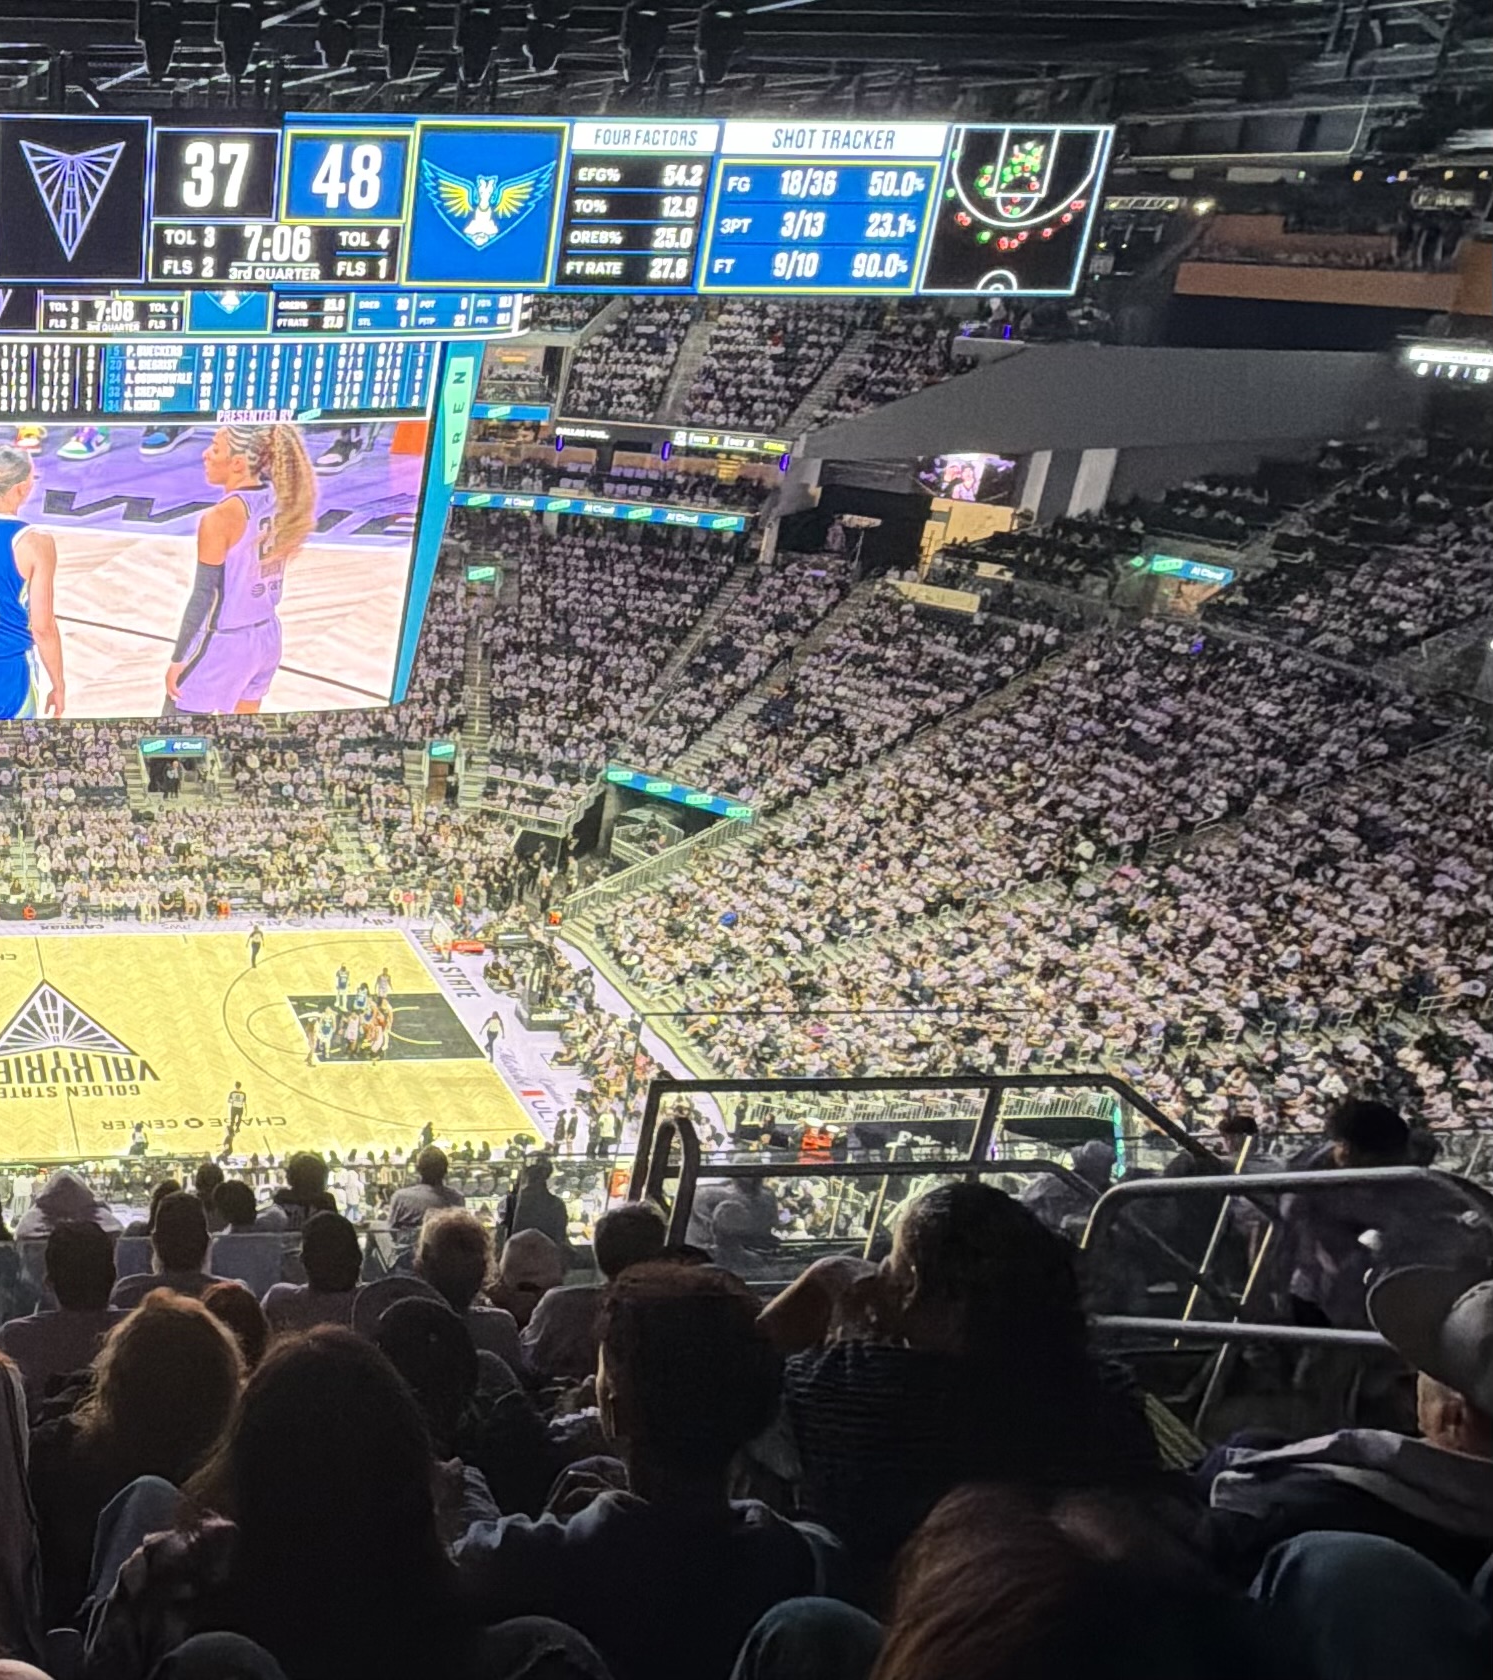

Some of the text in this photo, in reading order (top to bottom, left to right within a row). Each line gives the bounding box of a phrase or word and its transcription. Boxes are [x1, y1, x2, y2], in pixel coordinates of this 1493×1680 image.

[594, 130, 698, 147] FOUR FACTORS
[772, 129, 896, 151] SHOT TRACKER
[182, 142, 250, 208] 37
[311, 144, 382, 210] 48
[578, 167, 621, 183] EFG%
[663, 164, 703, 188] 54.2
[727, 176, 751, 192] FG
[779, 170, 837, 196] 18/36
[868, 171, 925, 196] 50.0%
[574, 199, 608, 215] TO%
[720, 218, 751, 235] 3PT
[779, 212, 826, 238] 3/13
[865, 213, 916, 238] 23.1%
[164, 229, 215, 248] TOL 3
[243, 225, 311, 261] 7:06
[338, 230, 390, 249] TOL 4
[570, 230, 623, 247] OREB%
[163, 258, 214, 278] FLS 2
[228, 266, 321, 281] 3rd QUARTER
[336, 259, 388, 280] FLS 1
[566, 260, 622, 277] FT RATE
[713, 260, 733, 274] FT
[773, 253, 820, 280] 9/10
[852, 253, 908, 280] 90.0%
[48, 302, 69, 313] TOL
[149, 301, 179, 314] TOL 4
[102, 322, 141, 332] QUARTER
[217, 409, 294, 422] PRESENTED BY
[439, 966, 482, 999] STATE
[0, 1085, 141, 1098] GOLDEN STATE
